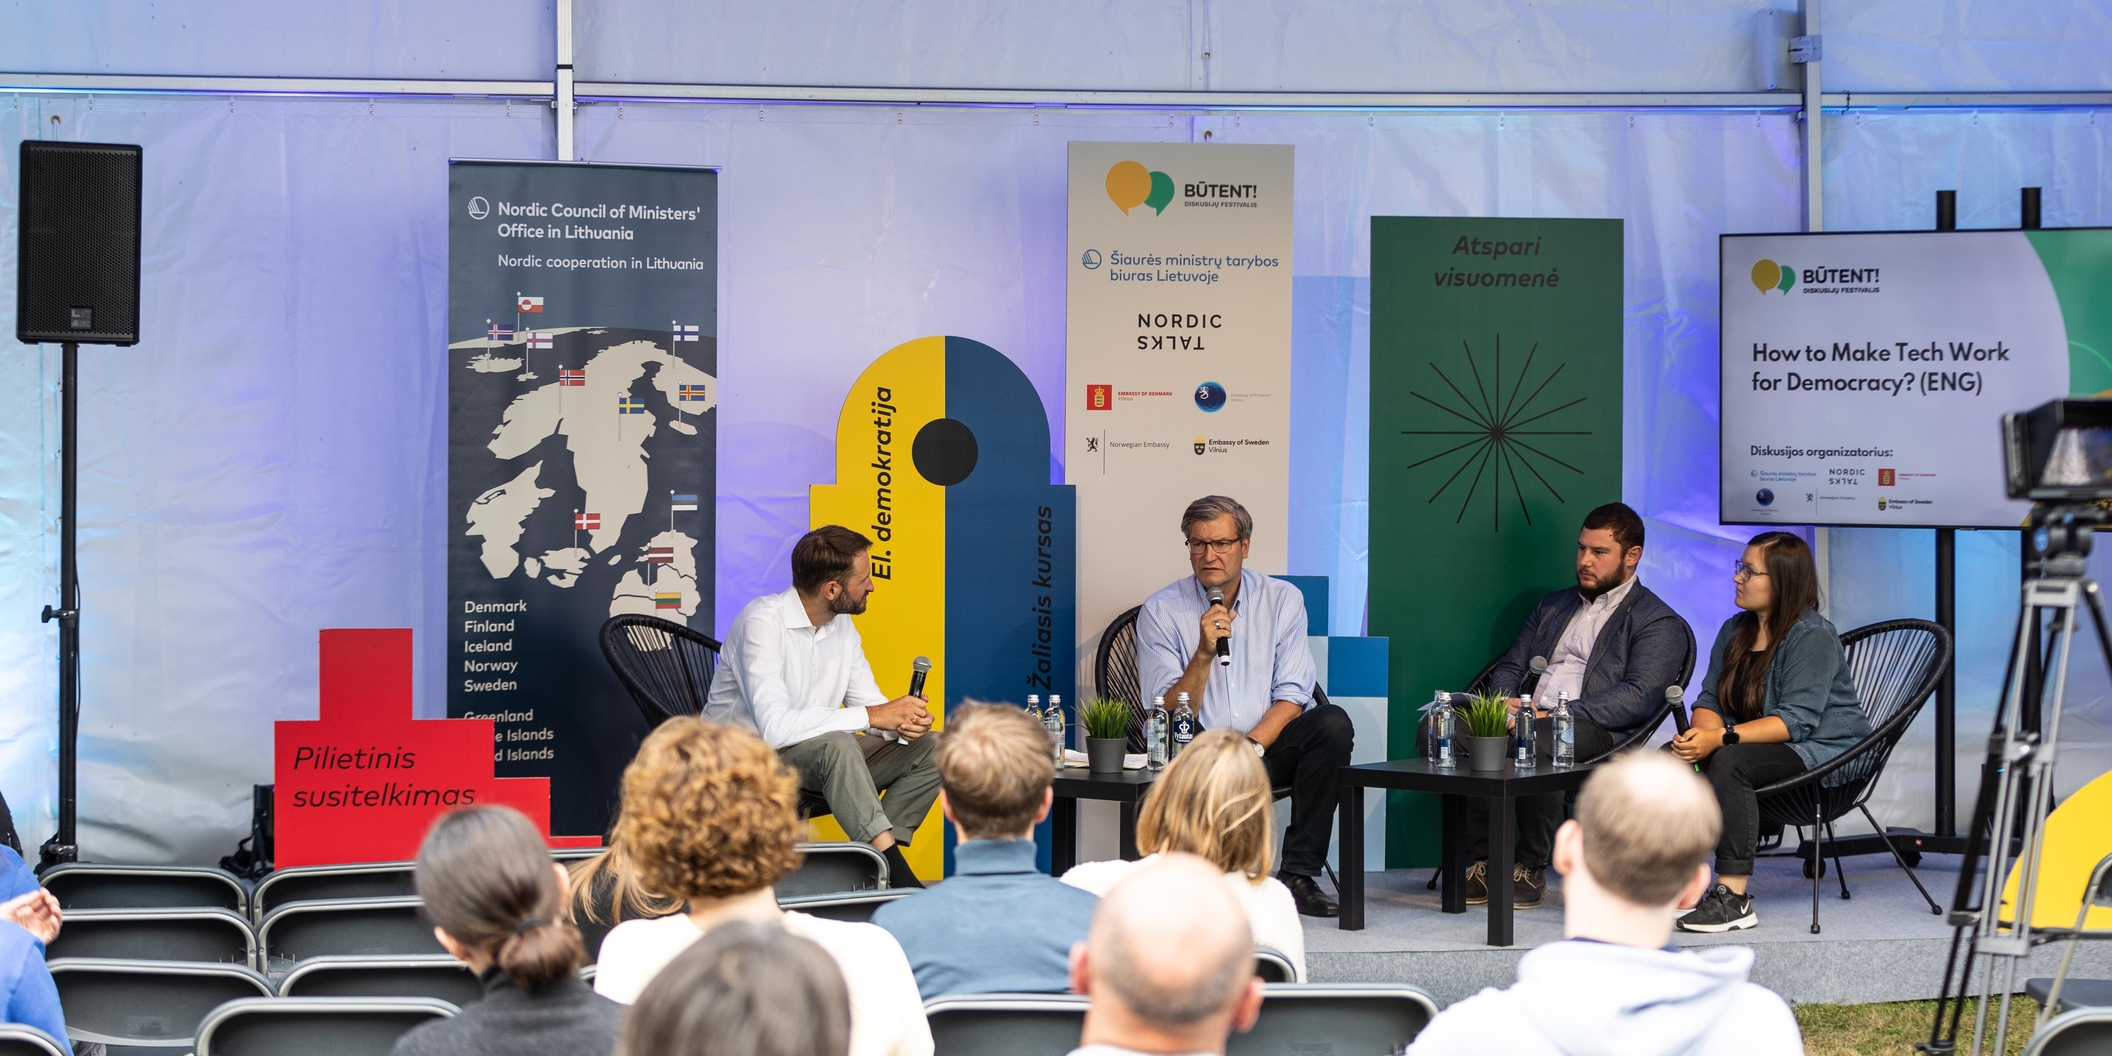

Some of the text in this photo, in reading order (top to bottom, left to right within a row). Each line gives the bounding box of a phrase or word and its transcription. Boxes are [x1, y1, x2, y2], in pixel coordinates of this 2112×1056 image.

[1184, 181, 1258, 198] BŪTENT!
[498, 201, 701, 221] Nordic Council of Ministers'
[1184, 201, 1220, 209] DISKUSIJŲ
[497, 223, 634, 241] Office in Lithuania
[1451, 235, 1542, 260] Atspari
[498, 254, 704, 271] Nordic cooperation in Lithuania
[1110, 250, 1279, 270] Šiaurės ministrų tarybos
[1110, 269, 1219, 285] biuras Lietuvoje
[1434, 266, 1560, 288] visuomenė
[1803, 266, 1880, 284] BŪTENT!
[1138, 313, 1222, 329] NORDIC
[1137, 335, 1205, 350] TALKS
[1752, 340, 2011, 362] How to Make Tech Work
[1751, 371, 1983, 396] for Democracy? (ENG)
[1750, 445, 1894, 459] Diskusijos organizatorius:
[870, 386, 897, 581] El. demokratija
[464, 599, 527, 614] Denmark
[1026, 505, 1053, 691] Žaliasis kursas
[464, 619, 515, 633] Finland
[464, 639, 513, 653] Iceland
[464, 660, 518, 674] Norway
[464, 678, 518, 692] Sweden
[507, 727, 554, 742] Islands
[294, 746, 416, 770] Pilietinis
[507, 746, 555, 761] Islands
[292, 782, 476, 808] susitelkimas
